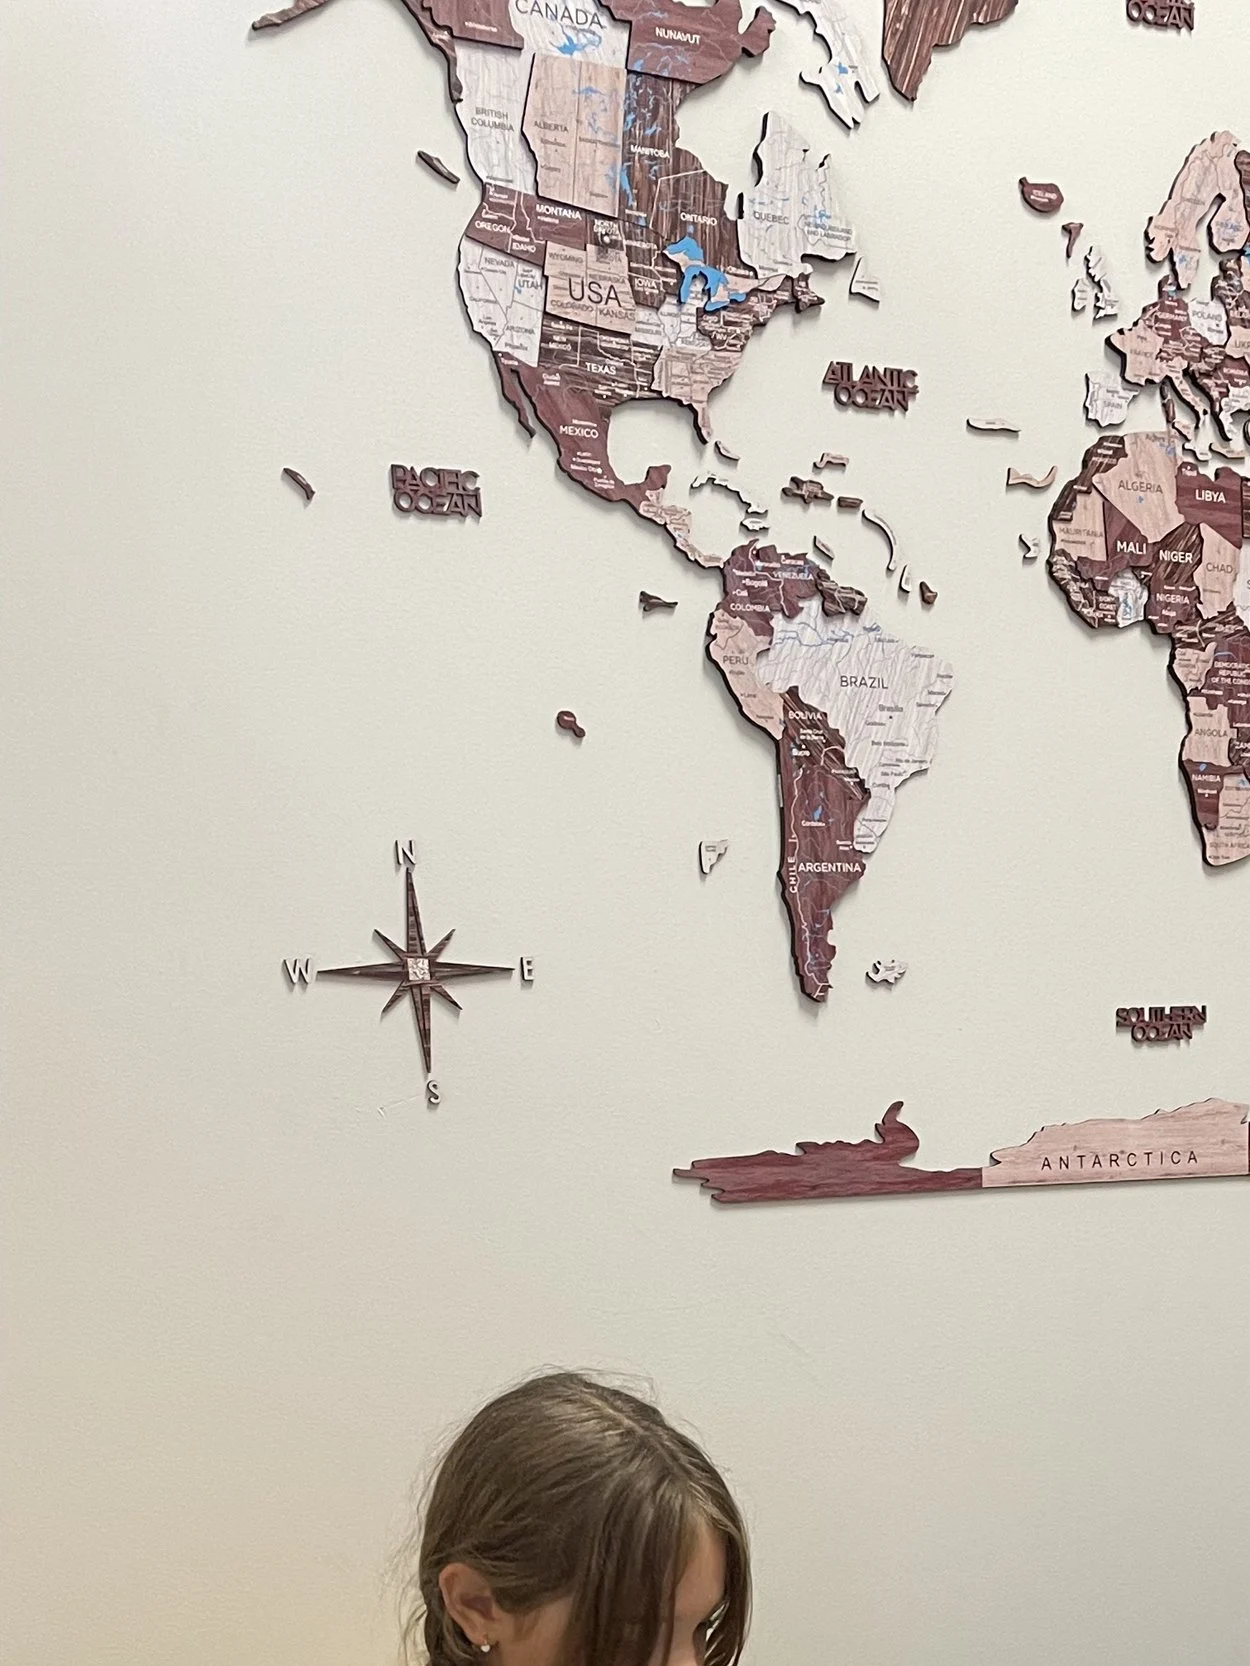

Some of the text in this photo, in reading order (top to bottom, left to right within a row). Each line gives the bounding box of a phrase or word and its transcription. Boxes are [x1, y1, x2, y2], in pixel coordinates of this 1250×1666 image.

[515, 0, 604, 29] CANADA
[656, 27, 700, 45] NUNAVUT
[475, 107, 508, 119] BRITISH
[471, 118, 514, 132] COLUMBIA
[536, 204, 582, 220] MONTANA
[680, 212, 718, 226] ONTARIO
[753, 210, 790, 225] QUEBEC
[475, 221, 512, 233] OREGON
[484, 257, 515, 268] NEVADA
[518, 280, 543, 291] UTAH
[634, 278, 657, 290] IOWA
[568, 277, 622, 307] USA
[585, 361, 617, 376] TEXAS
[822, 361, 920, 393] ATLANTIC
[559, 425, 599, 439] MEXICO
[1117, 479, 1163, 494] ALGERIA
[1195, 488, 1226, 503] LIBYA
[1116, 540, 1148, 555] MALI
[1158, 549, 1194, 563] NIGER
[1205, 562, 1233, 574] CHAD
[1156, 592, 1190, 604] NIGERIA
[729, 602, 772, 614] COLOMBIA
[722, 655, 750, 666] PERU
[839, 674, 890, 690] BRAZIL
[1194, 728, 1229, 738] ANGOLA
[1191, 773, 1222, 783] NAMIBIA
[393, 839, 418, 866] N
[787, 855, 799, 894] CHILE
[797, 861, 863, 873] ARGENTINA
[282, 957, 315, 985] W
[519, 956, 536, 982] E
[426, 1079, 443, 1106] S
[1040, 1150, 1199, 1171] ANTARCTICA
